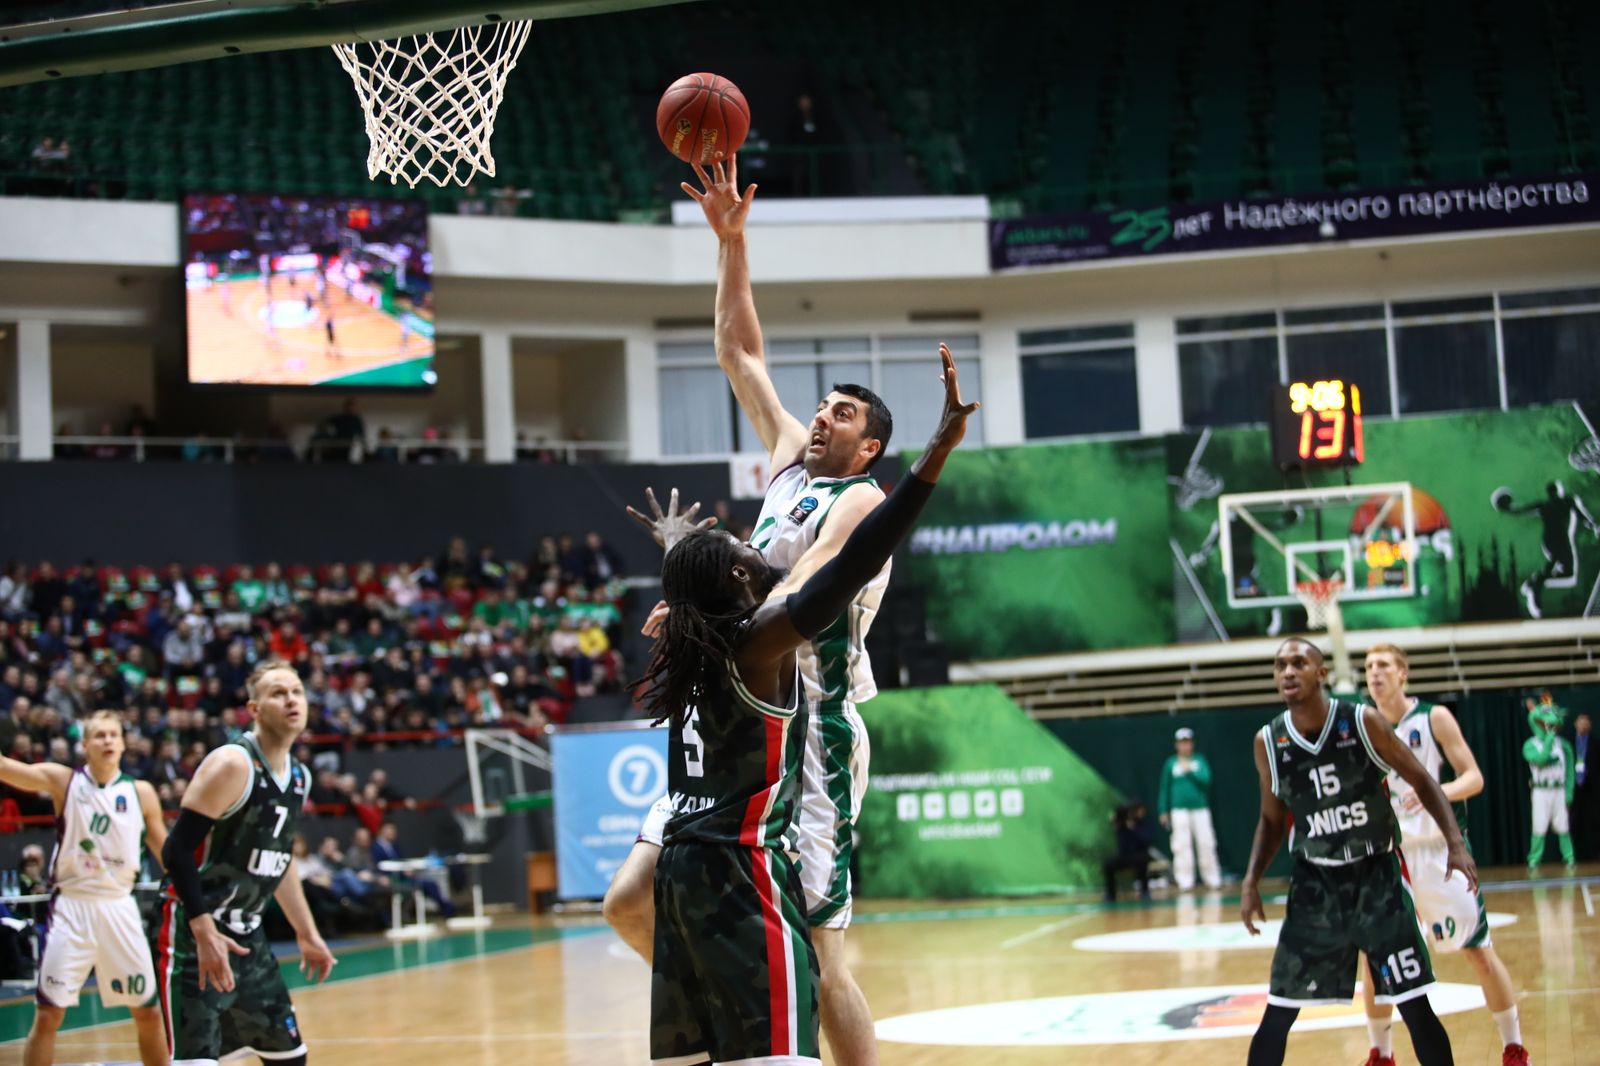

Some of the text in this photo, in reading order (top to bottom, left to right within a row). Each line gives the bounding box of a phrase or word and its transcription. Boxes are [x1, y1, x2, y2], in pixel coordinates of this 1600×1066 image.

[1109, 181, 1590, 251] 25 лет Надёжного партнёрства
[1299, 410, 1346, 459] 13
[682, 704, 704, 777] 5
[627, 760, 649, 793] 7
[1308, 763, 1341, 800] 15
[89, 811, 110, 835] 10
[272, 805, 289, 839] 7
[1445, 915, 1456, 939] 9
[1387, 946, 1421, 985] 15
[127, 973, 146, 995] 10
